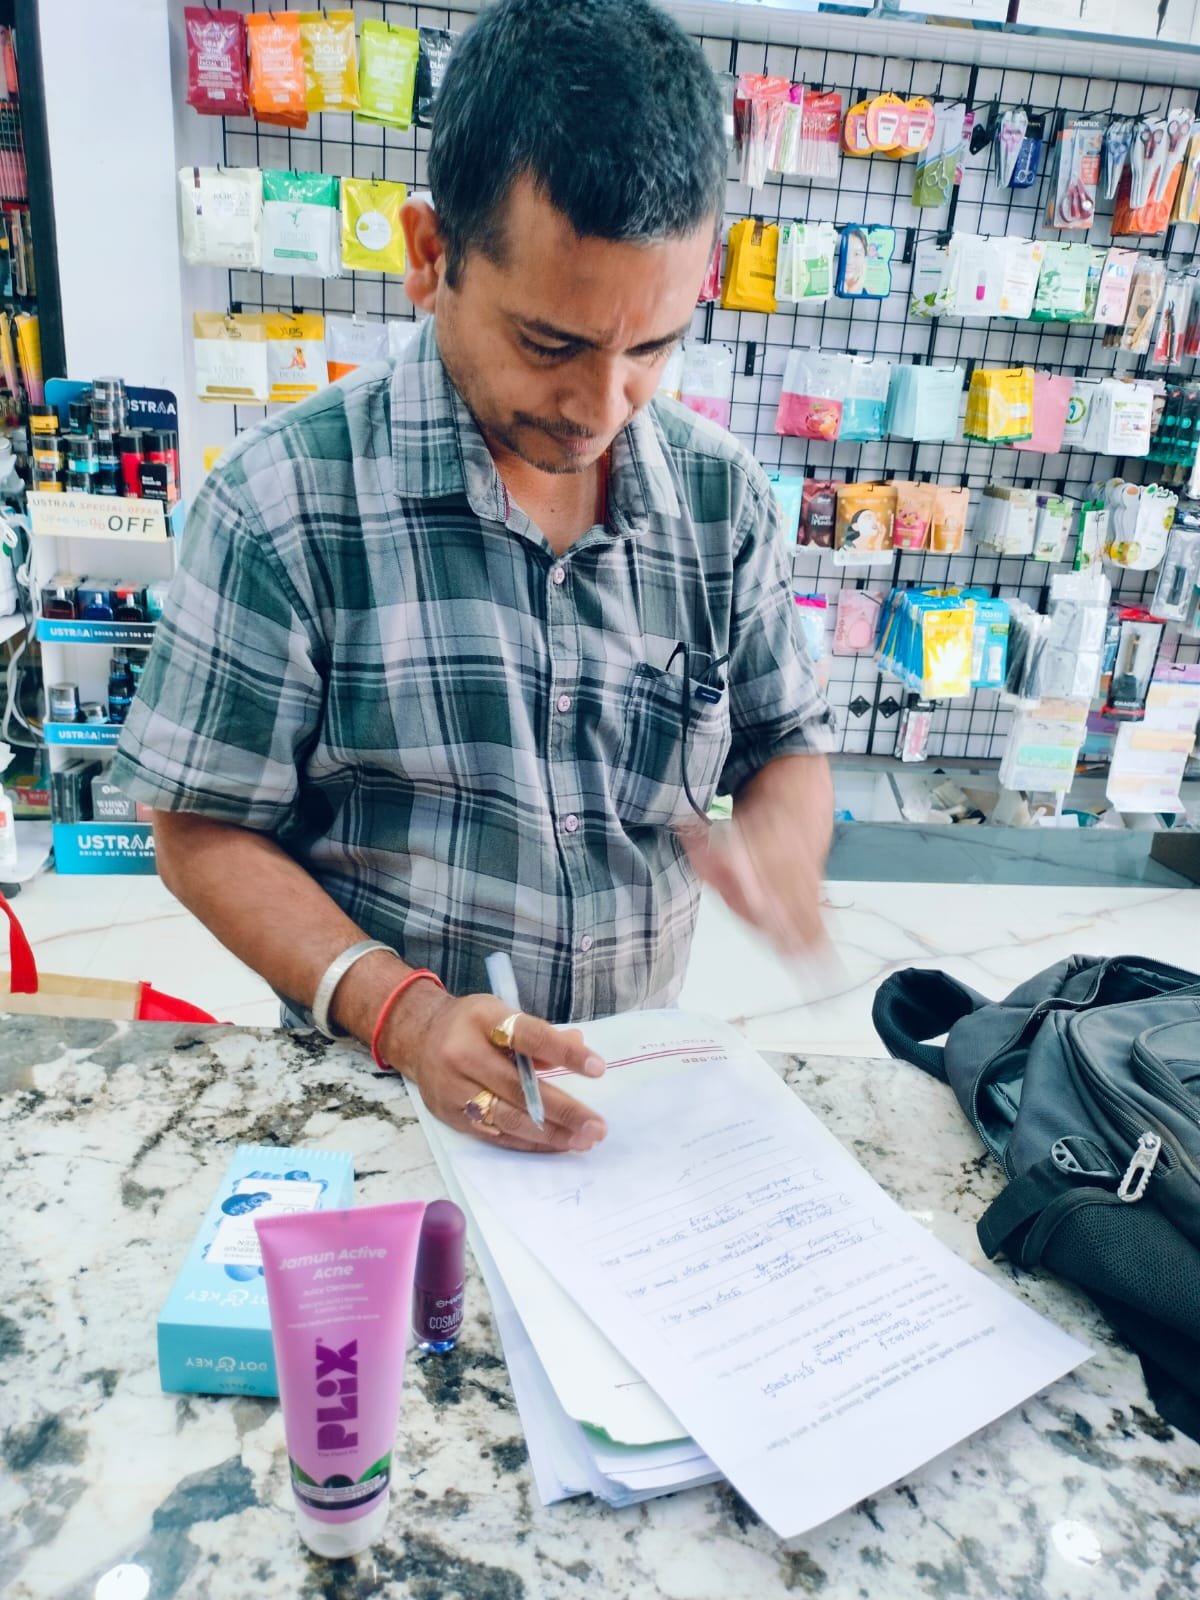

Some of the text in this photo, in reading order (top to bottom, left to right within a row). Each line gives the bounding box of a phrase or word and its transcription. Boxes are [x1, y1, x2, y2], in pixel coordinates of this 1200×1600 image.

[127, 400, 177, 415] STRAA
[107, 515, 155, 533] OFF
[50, 627, 90, 637] USTRAA
[58, 730, 98, 740] USTRAA
[77, 834, 155, 849] USTRAA
[278, 1246, 388, 1271] Jamun Active
[312, 1265, 354, 1280] Acne
[185, 1356, 213, 1369] KEY
[239, 1361, 269, 1372] DOT
